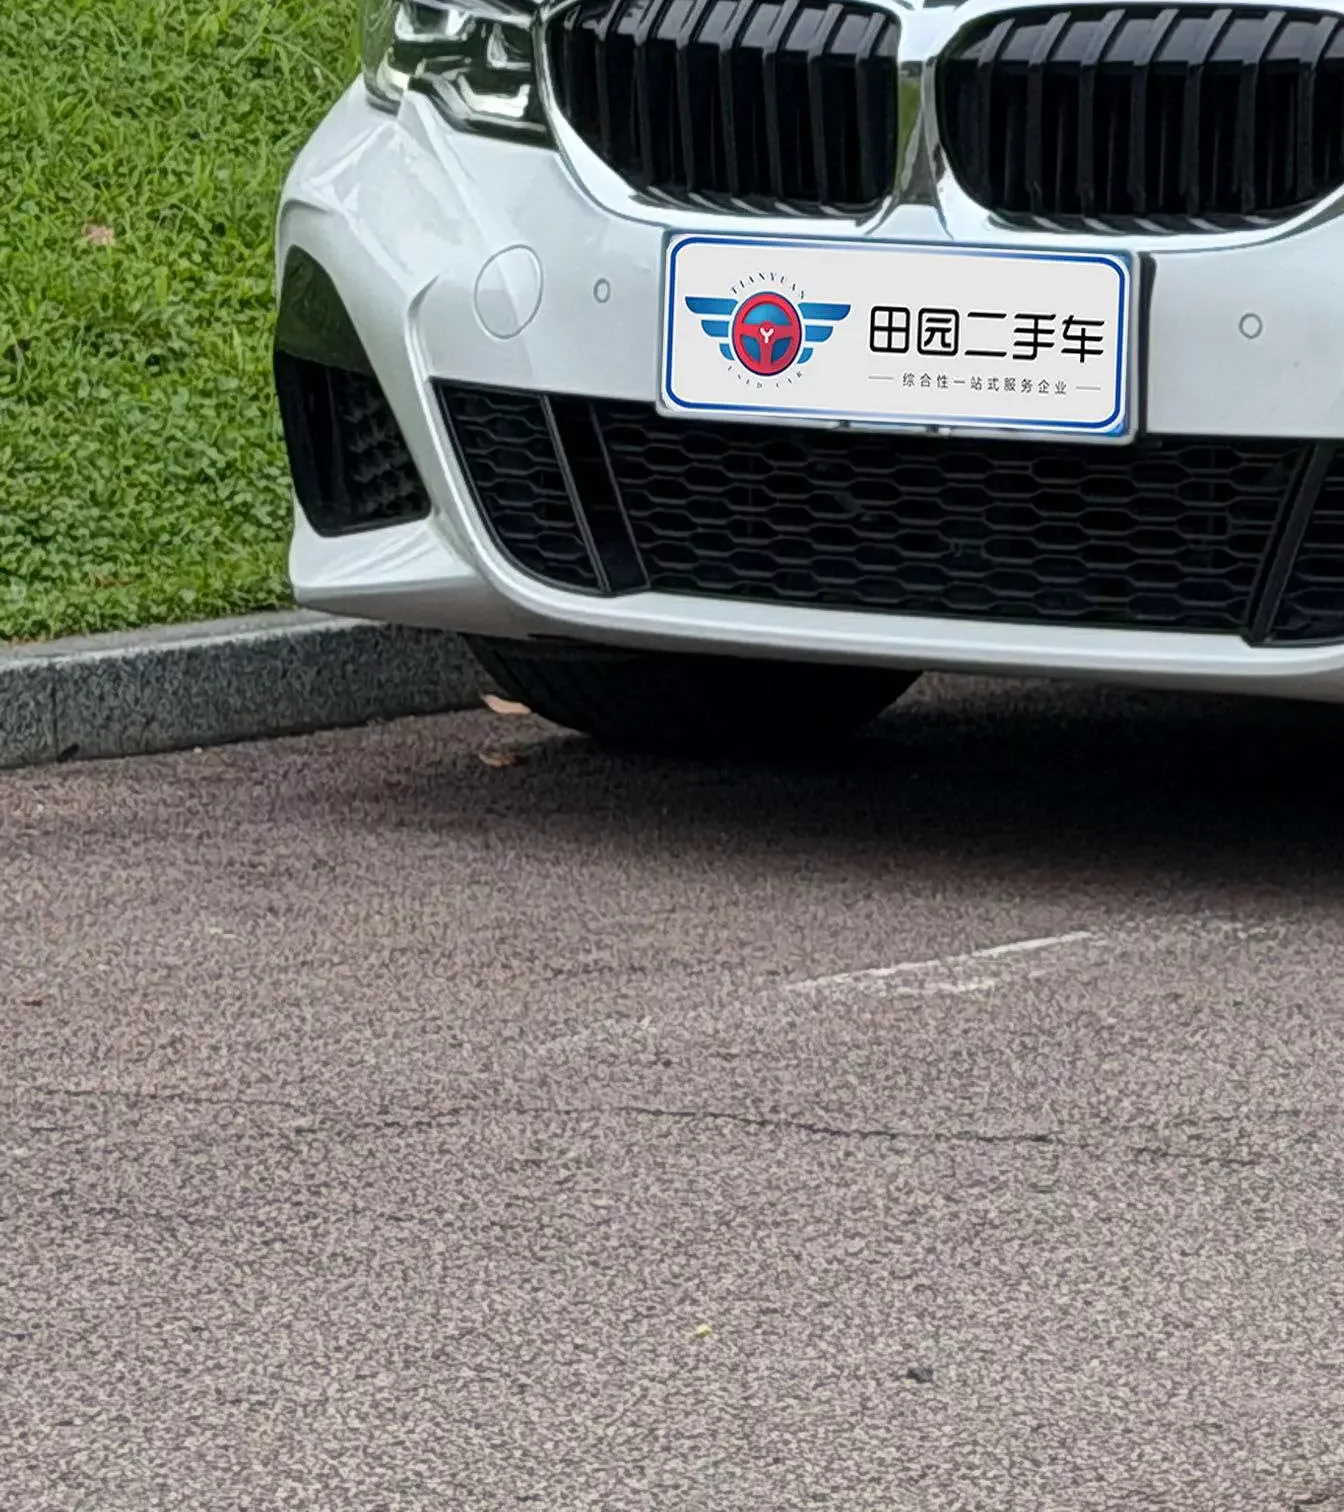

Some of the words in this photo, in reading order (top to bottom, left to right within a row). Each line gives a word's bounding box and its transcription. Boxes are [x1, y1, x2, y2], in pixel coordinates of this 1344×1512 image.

[869, 305, 1105, 363] 田园二手车
[901, 372, 1067, 395] 综合性一站式服务企业
